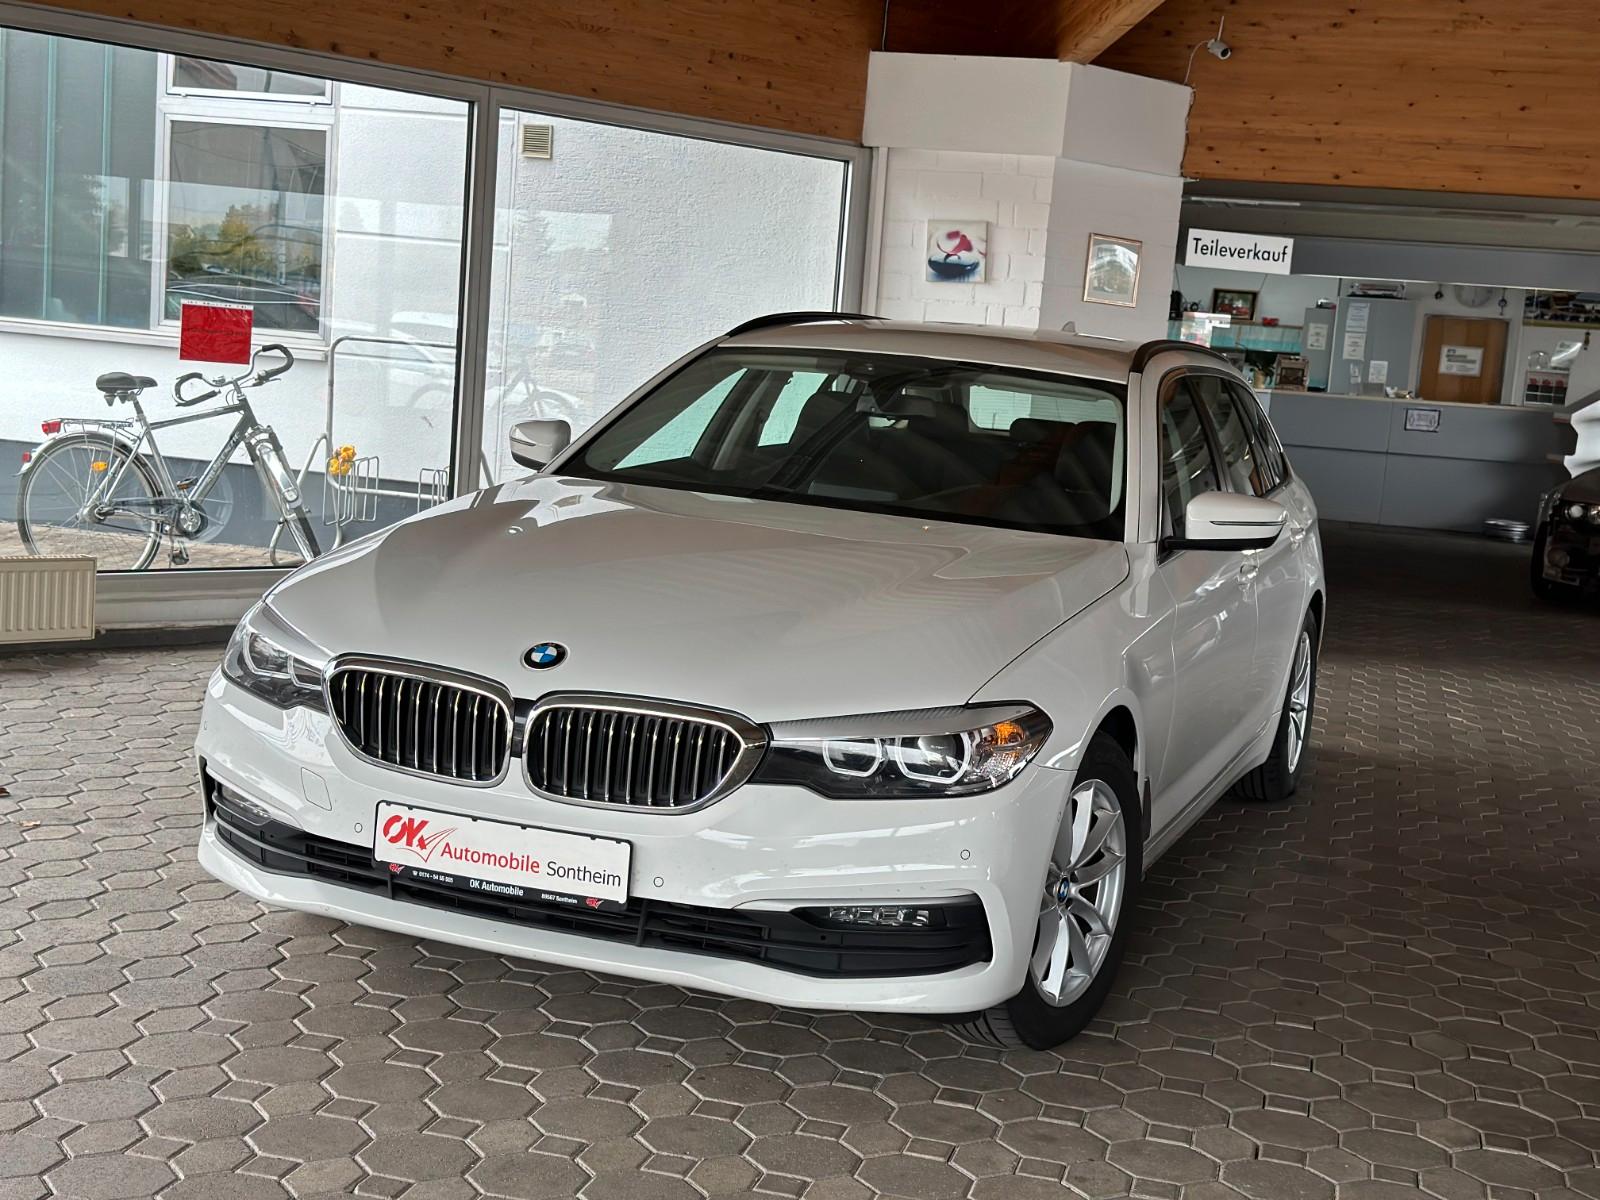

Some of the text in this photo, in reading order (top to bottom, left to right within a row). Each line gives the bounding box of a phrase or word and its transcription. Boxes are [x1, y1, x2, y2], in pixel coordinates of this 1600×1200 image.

[1192, 237, 1289, 263] Teileverkauf
[382, 814, 621, 887] OK Automobile Sontheim
[469, 878, 524, 896] OK Automobile
